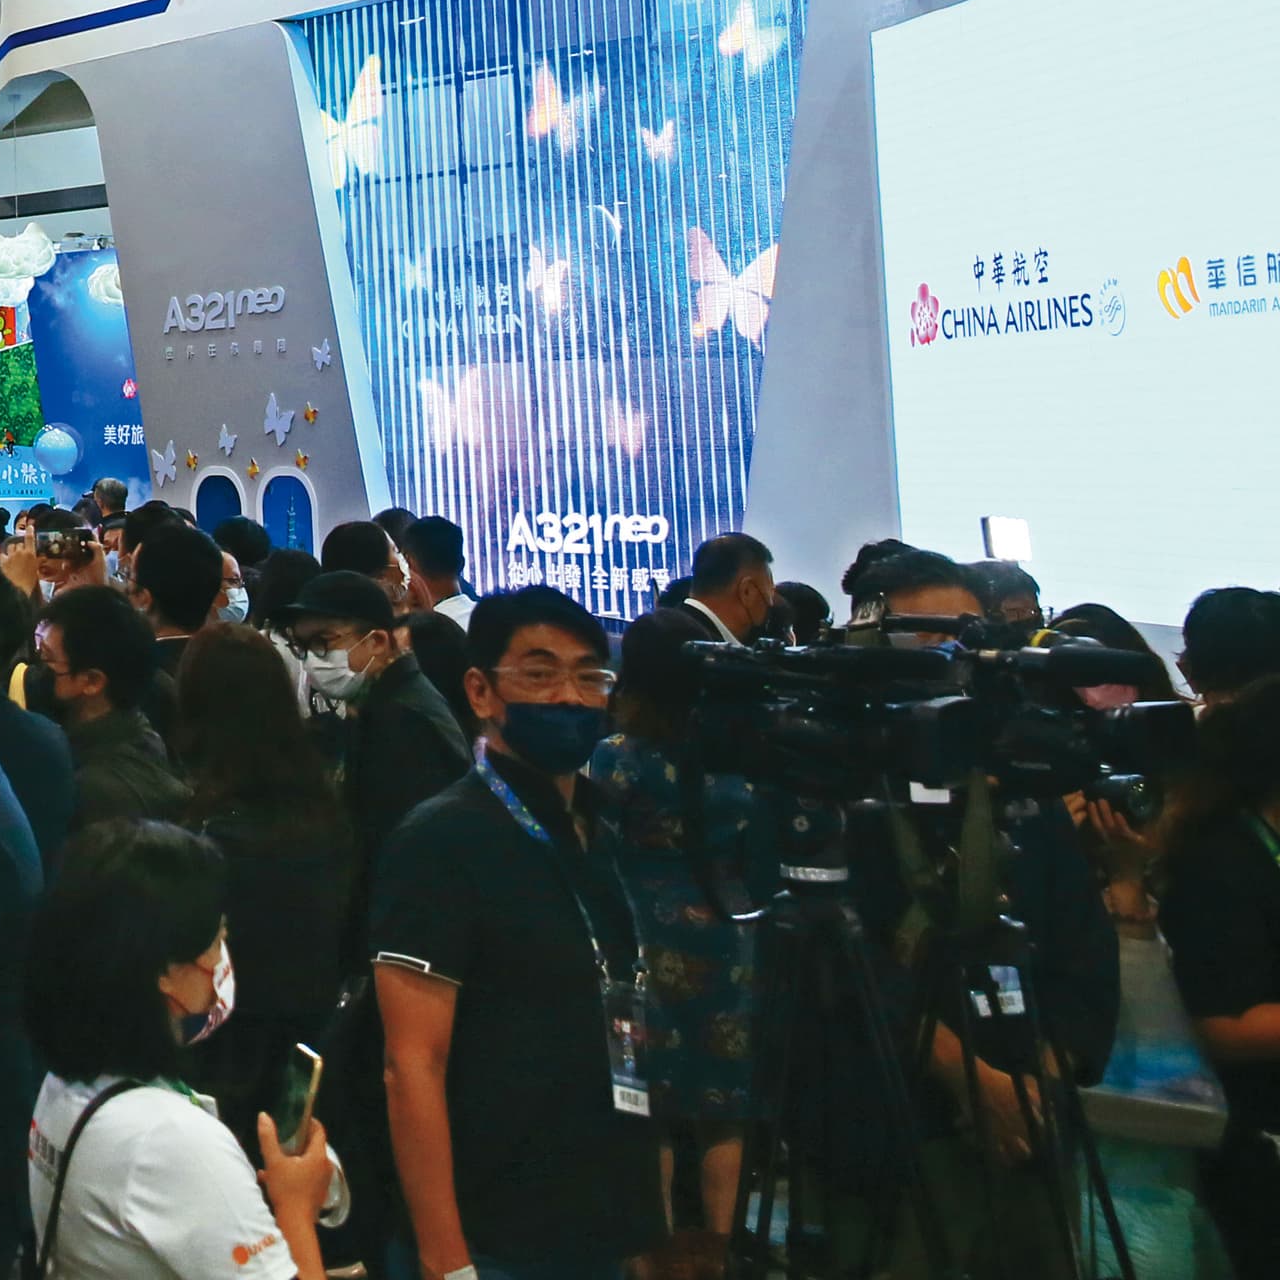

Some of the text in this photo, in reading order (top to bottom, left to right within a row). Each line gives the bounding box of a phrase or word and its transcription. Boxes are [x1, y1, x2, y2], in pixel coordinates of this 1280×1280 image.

[973, 248, 1049, 293] 中華航空
[163, 286, 286, 334] A321neo
[942, 293, 1093, 339] CHINA AIRLINES
[103, 424, 145, 446] 美好旅
[506, 511, 670, 556] A321neo
